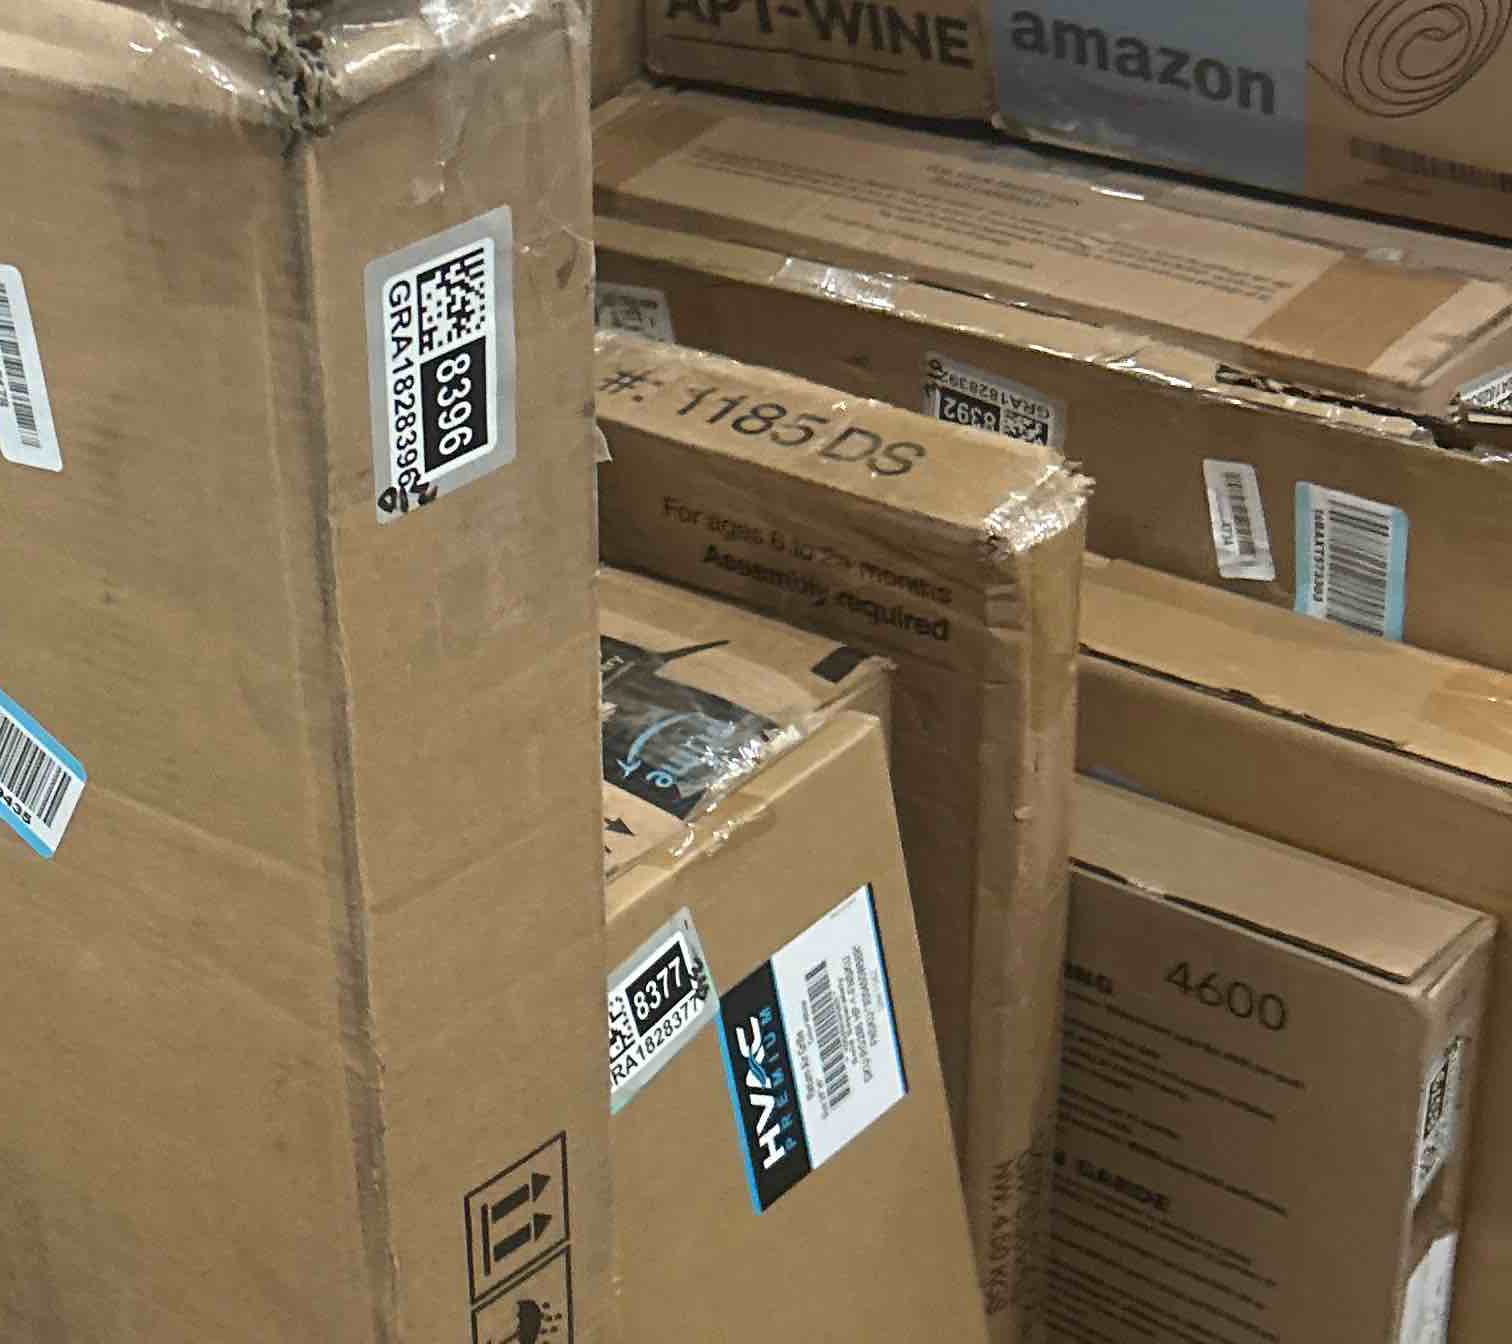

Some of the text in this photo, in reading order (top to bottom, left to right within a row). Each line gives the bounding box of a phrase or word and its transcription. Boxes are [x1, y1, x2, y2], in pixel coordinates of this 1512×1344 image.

[1010, 8, 1276, 116] amazon
[388, 279, 420, 490] GRA1828396
[436, 352, 473, 457] 8396
[662, 495, 705, 526] For
[701, 543, 952, 643] Assembly required
[610, 989, 702, 1087] RA1828377
[632, 955, 686, 1022] 8377
[1164, 960, 1287, 1032] 4600
[735, 1016, 786, 1169] HVAC
[760, 1006, 798, 1153] PREMIUM
